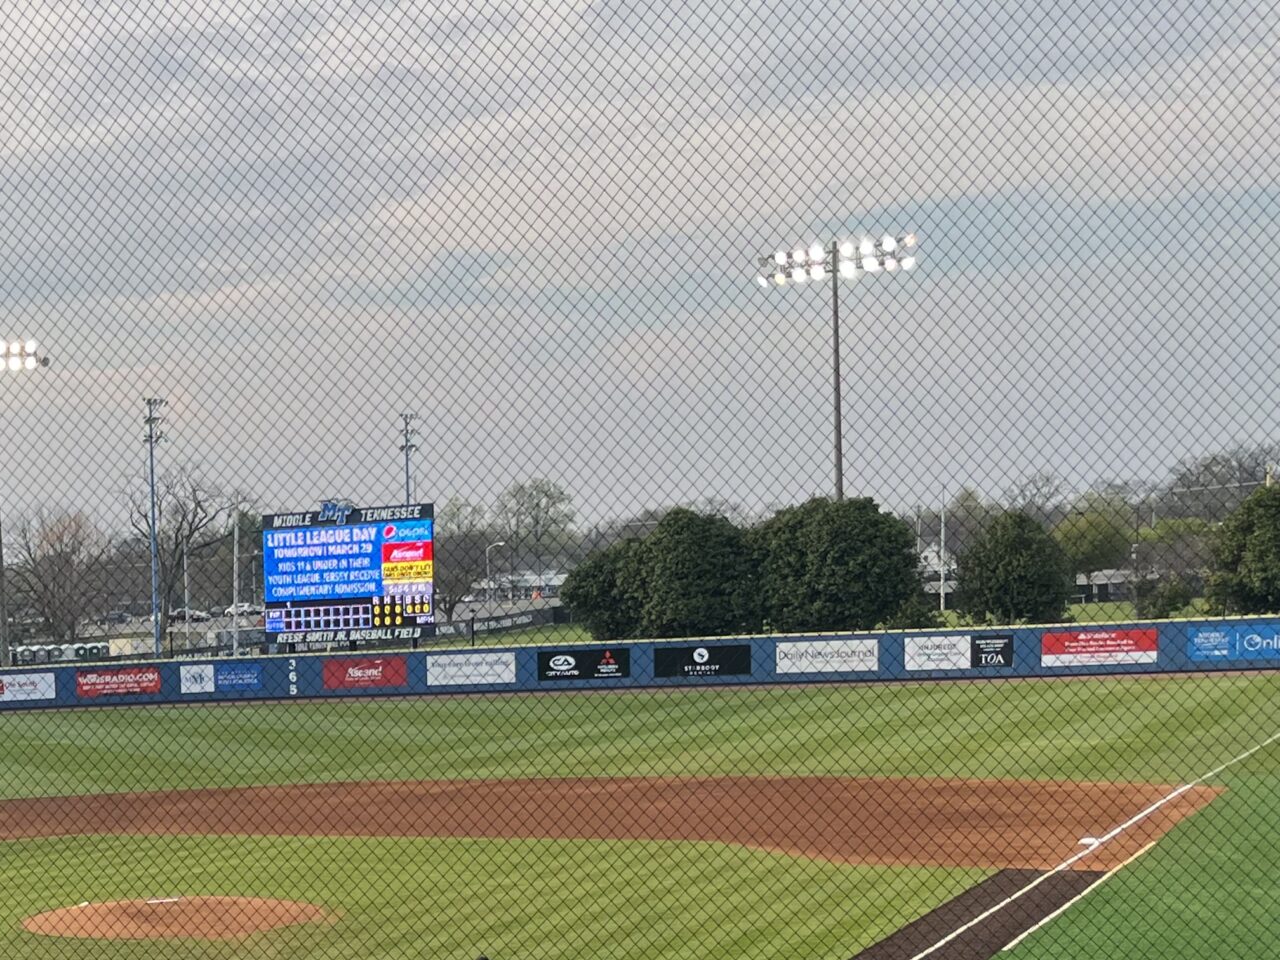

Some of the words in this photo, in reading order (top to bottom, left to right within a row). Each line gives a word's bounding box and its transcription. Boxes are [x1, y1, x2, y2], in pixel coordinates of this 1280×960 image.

[273, 514, 312, 527] MIDDLE
[318, 502, 352, 525] MT
[361, 506, 421, 521] TENNESSEE
[267, 531, 305, 547] LITTLE
[306, 529, 351, 544] LEAGUE
[352, 527, 378, 541] DAY
[274, 546, 322, 559] TOMORROW
[328, 544, 360, 555] MARCH
[360, 543, 373, 553] 29
[278, 562, 296, 572] KIDS
[297, 561, 305, 571] 11
[312, 560, 338, 570] UNDER
[339, 559, 348, 568] IN
[349, 558, 371, 568] THEIR
[268, 575, 293, 585] YOUTH
[294, 573, 321, 583] LEAGUE
[322, 571, 349, 582] JERSEY
[350, 570, 381, 580] RECEIVE
[272, 585, 334, 597] COMPLIMENTARY
[384, 596, 390, 604] H
[405, 595, 412, 604] B
[414, 595, 420, 603] S
[374, 605, 380, 614] 0
[384, 605, 390, 614] 0
[395, 605, 401, 613] 0
[406, 605, 413, 614] 0
[415, 605, 421, 613] 0
[423, 604, 429, 613] 0
[374, 617, 380, 626] 0
[384, 616, 391, 625] 0
[395, 616, 402, 624] 0
[417, 616, 434, 624] MPH
[277, 632, 304, 643] REESE
[306, 631, 333, 642] SMITH
[349, 629, 393, 640] BASEBALL
[394, 628, 421, 638] FIELD
[779, 650, 803, 662] Daily
[979, 653, 1005, 664] TOA
